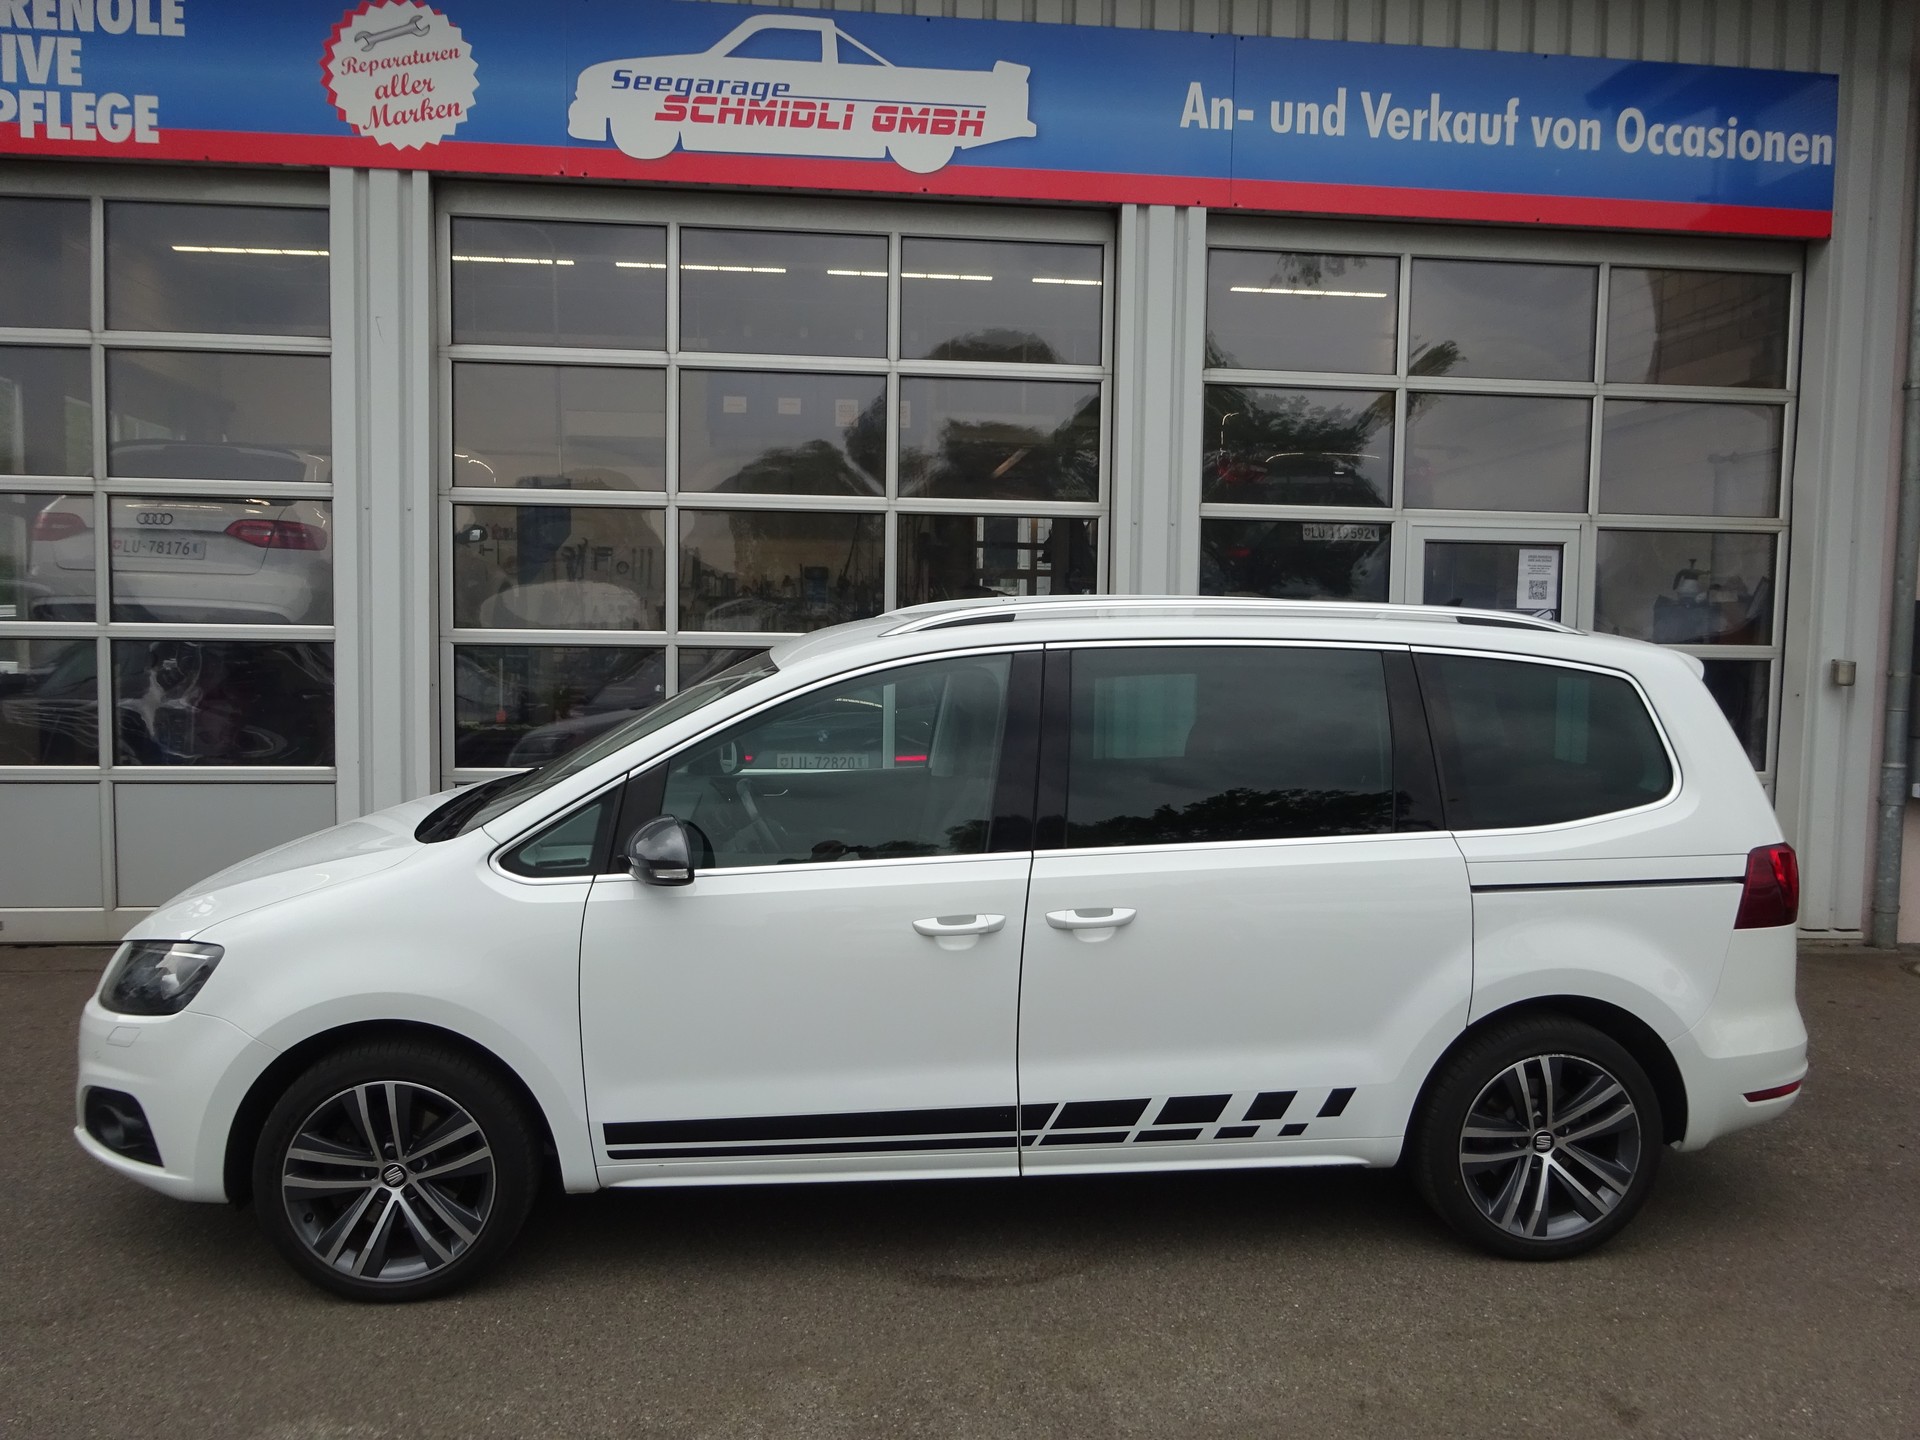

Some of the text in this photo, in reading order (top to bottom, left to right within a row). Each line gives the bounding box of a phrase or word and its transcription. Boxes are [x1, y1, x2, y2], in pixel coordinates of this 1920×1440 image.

[1, 33, 83, 86] IVE
[340, 47, 461, 77] Reparaturen
[374, 72, 436, 100] aller
[611, 69, 791, 102] Seegarage
[362, 97, 463, 130] Marken
[654, 95, 987, 137] SCHMIDLI GMBH
[1179, 81, 1833, 166] An- und Verkauf von Occasionen
